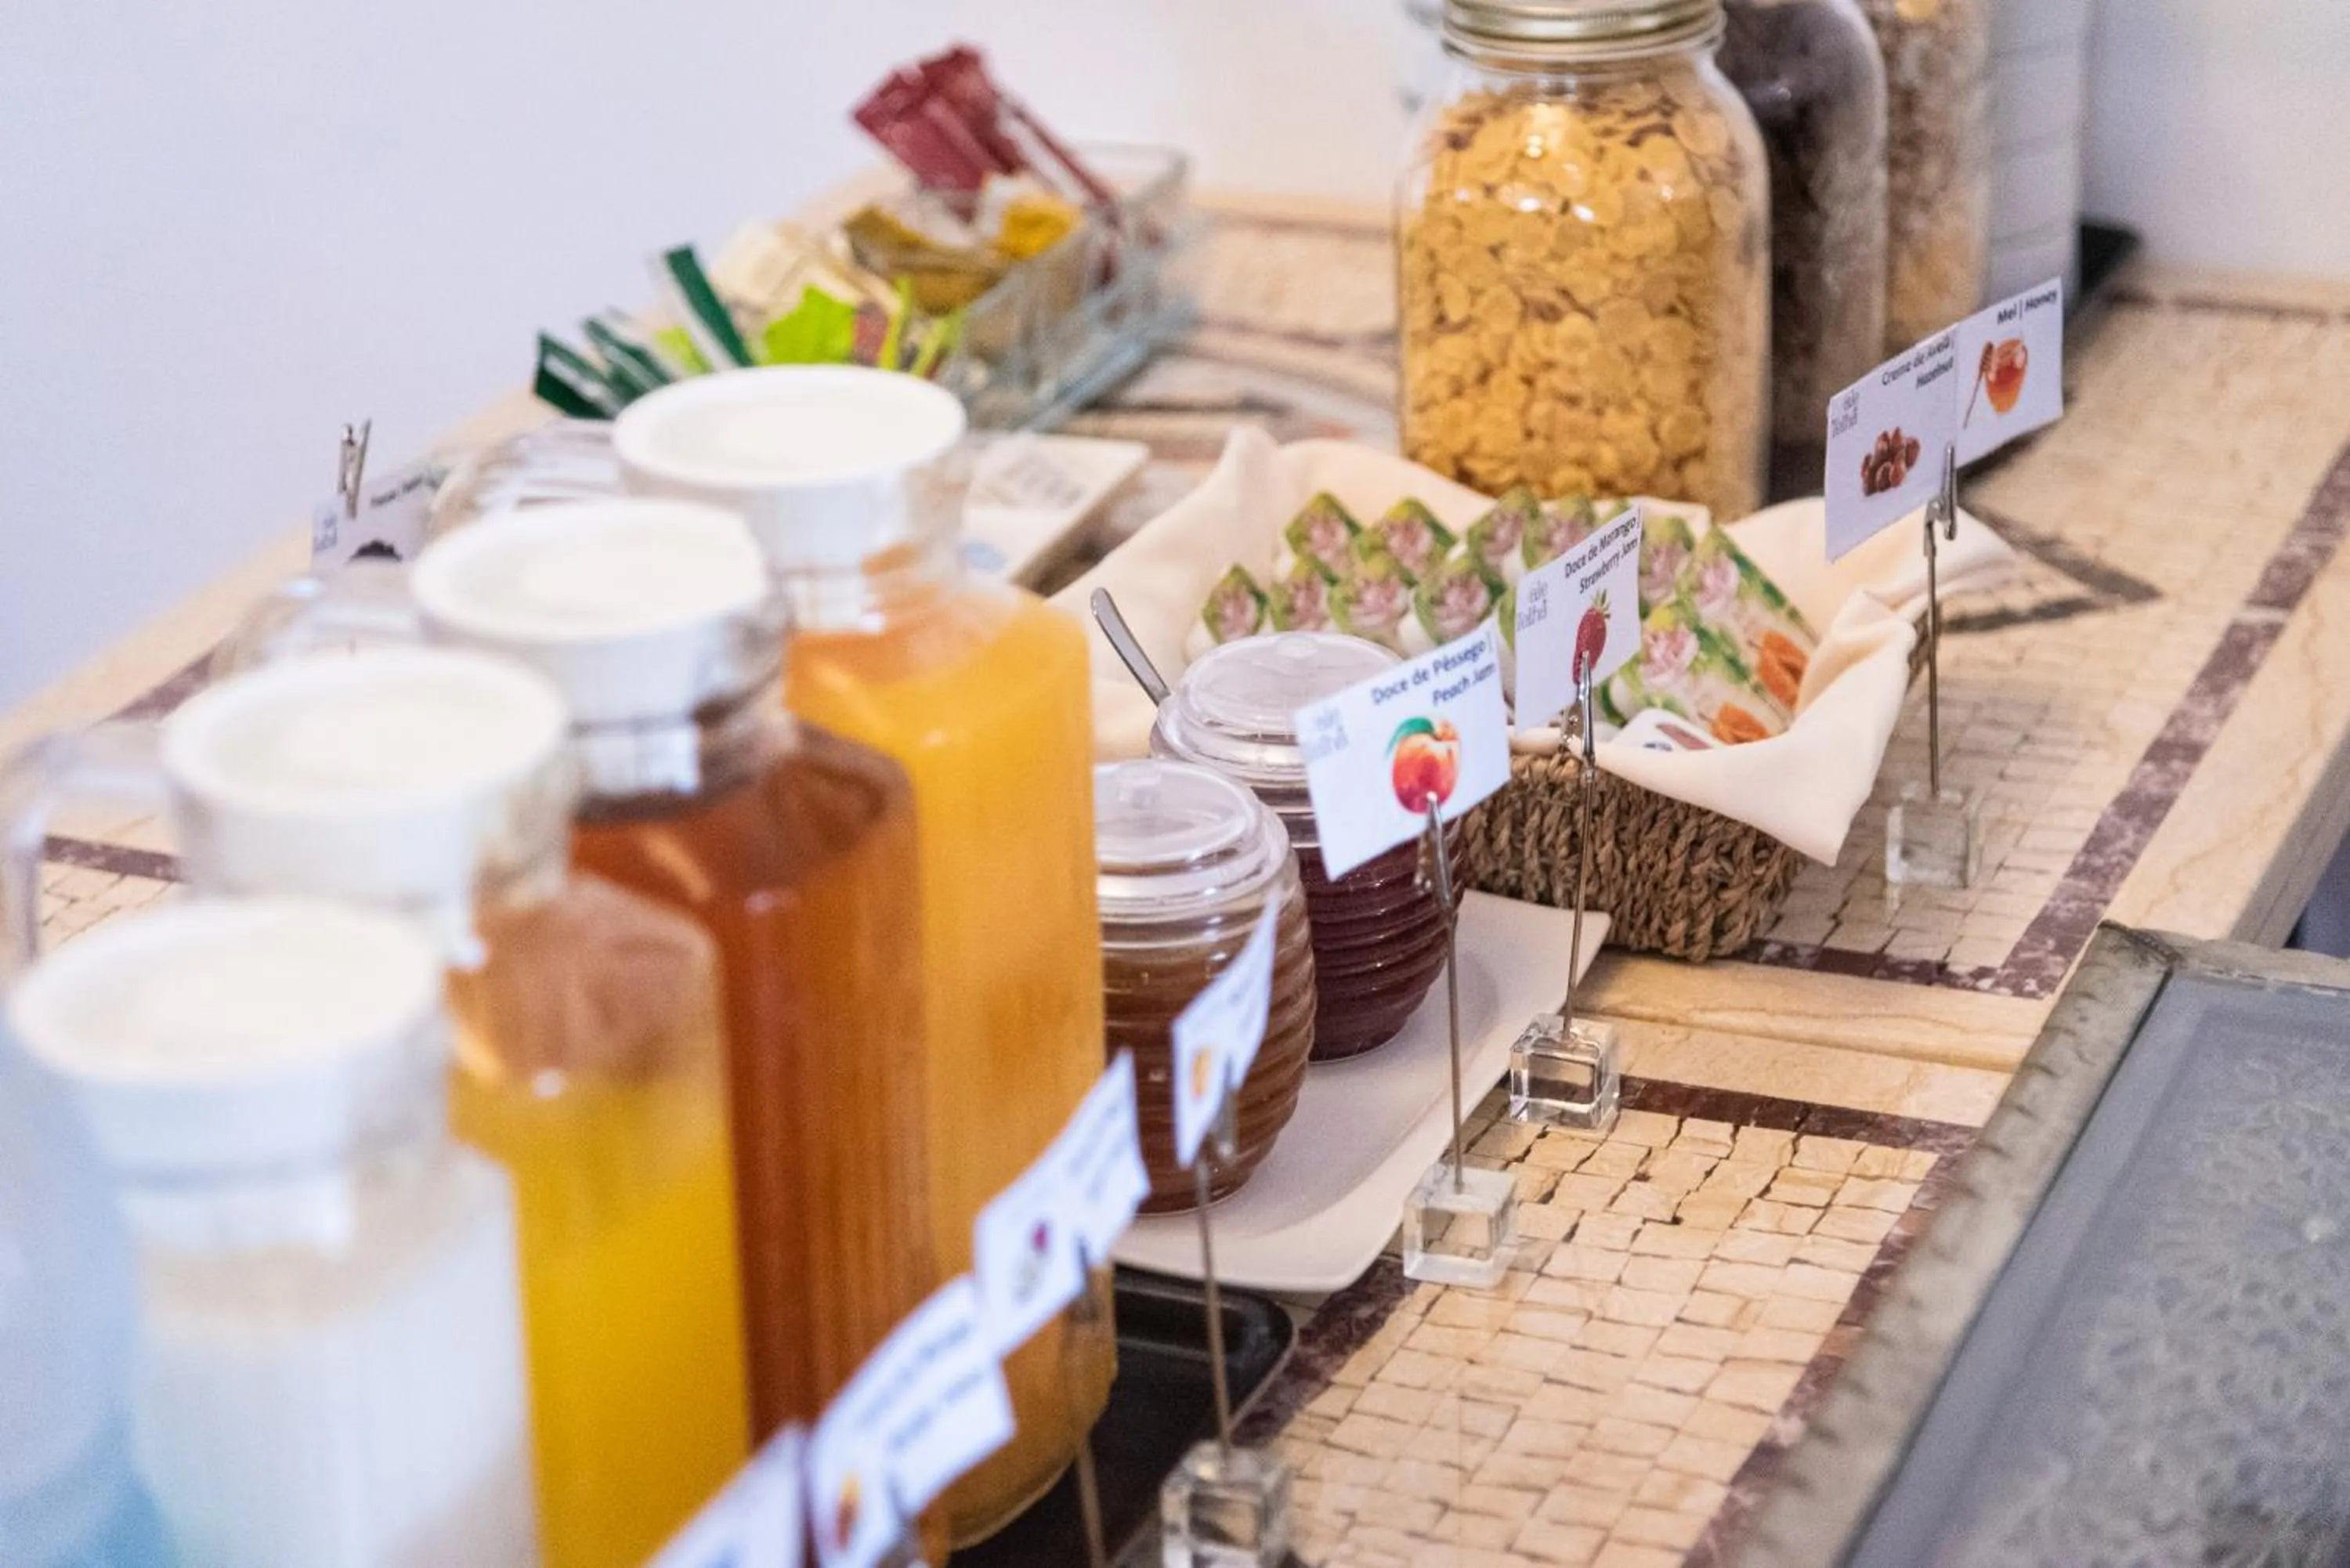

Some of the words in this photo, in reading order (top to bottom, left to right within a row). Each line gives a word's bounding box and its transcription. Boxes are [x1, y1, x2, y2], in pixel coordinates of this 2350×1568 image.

[1997, 302, 2018, 326] Mel
[2024, 289, 2058, 313] Honey
[1882, 360, 1911, 386] Creme
[1913, 350, 1925, 368] de
[1564, 554, 1587, 579] Doce
[1587, 544, 1599, 562] de
[1599, 516, 1636, 553] Morango
[1579, 549, 1621, 594] Strawberry
[1621, 537, 1639, 559] Jam
[1371, 677, 1408, 706] Doce
[1412, 667, 1430, 687] de
[1432, 639, 1487, 677] Pêssego
[1433, 675, 1471, 708] Peach
[1472, 662, 1496, 688] Jam
